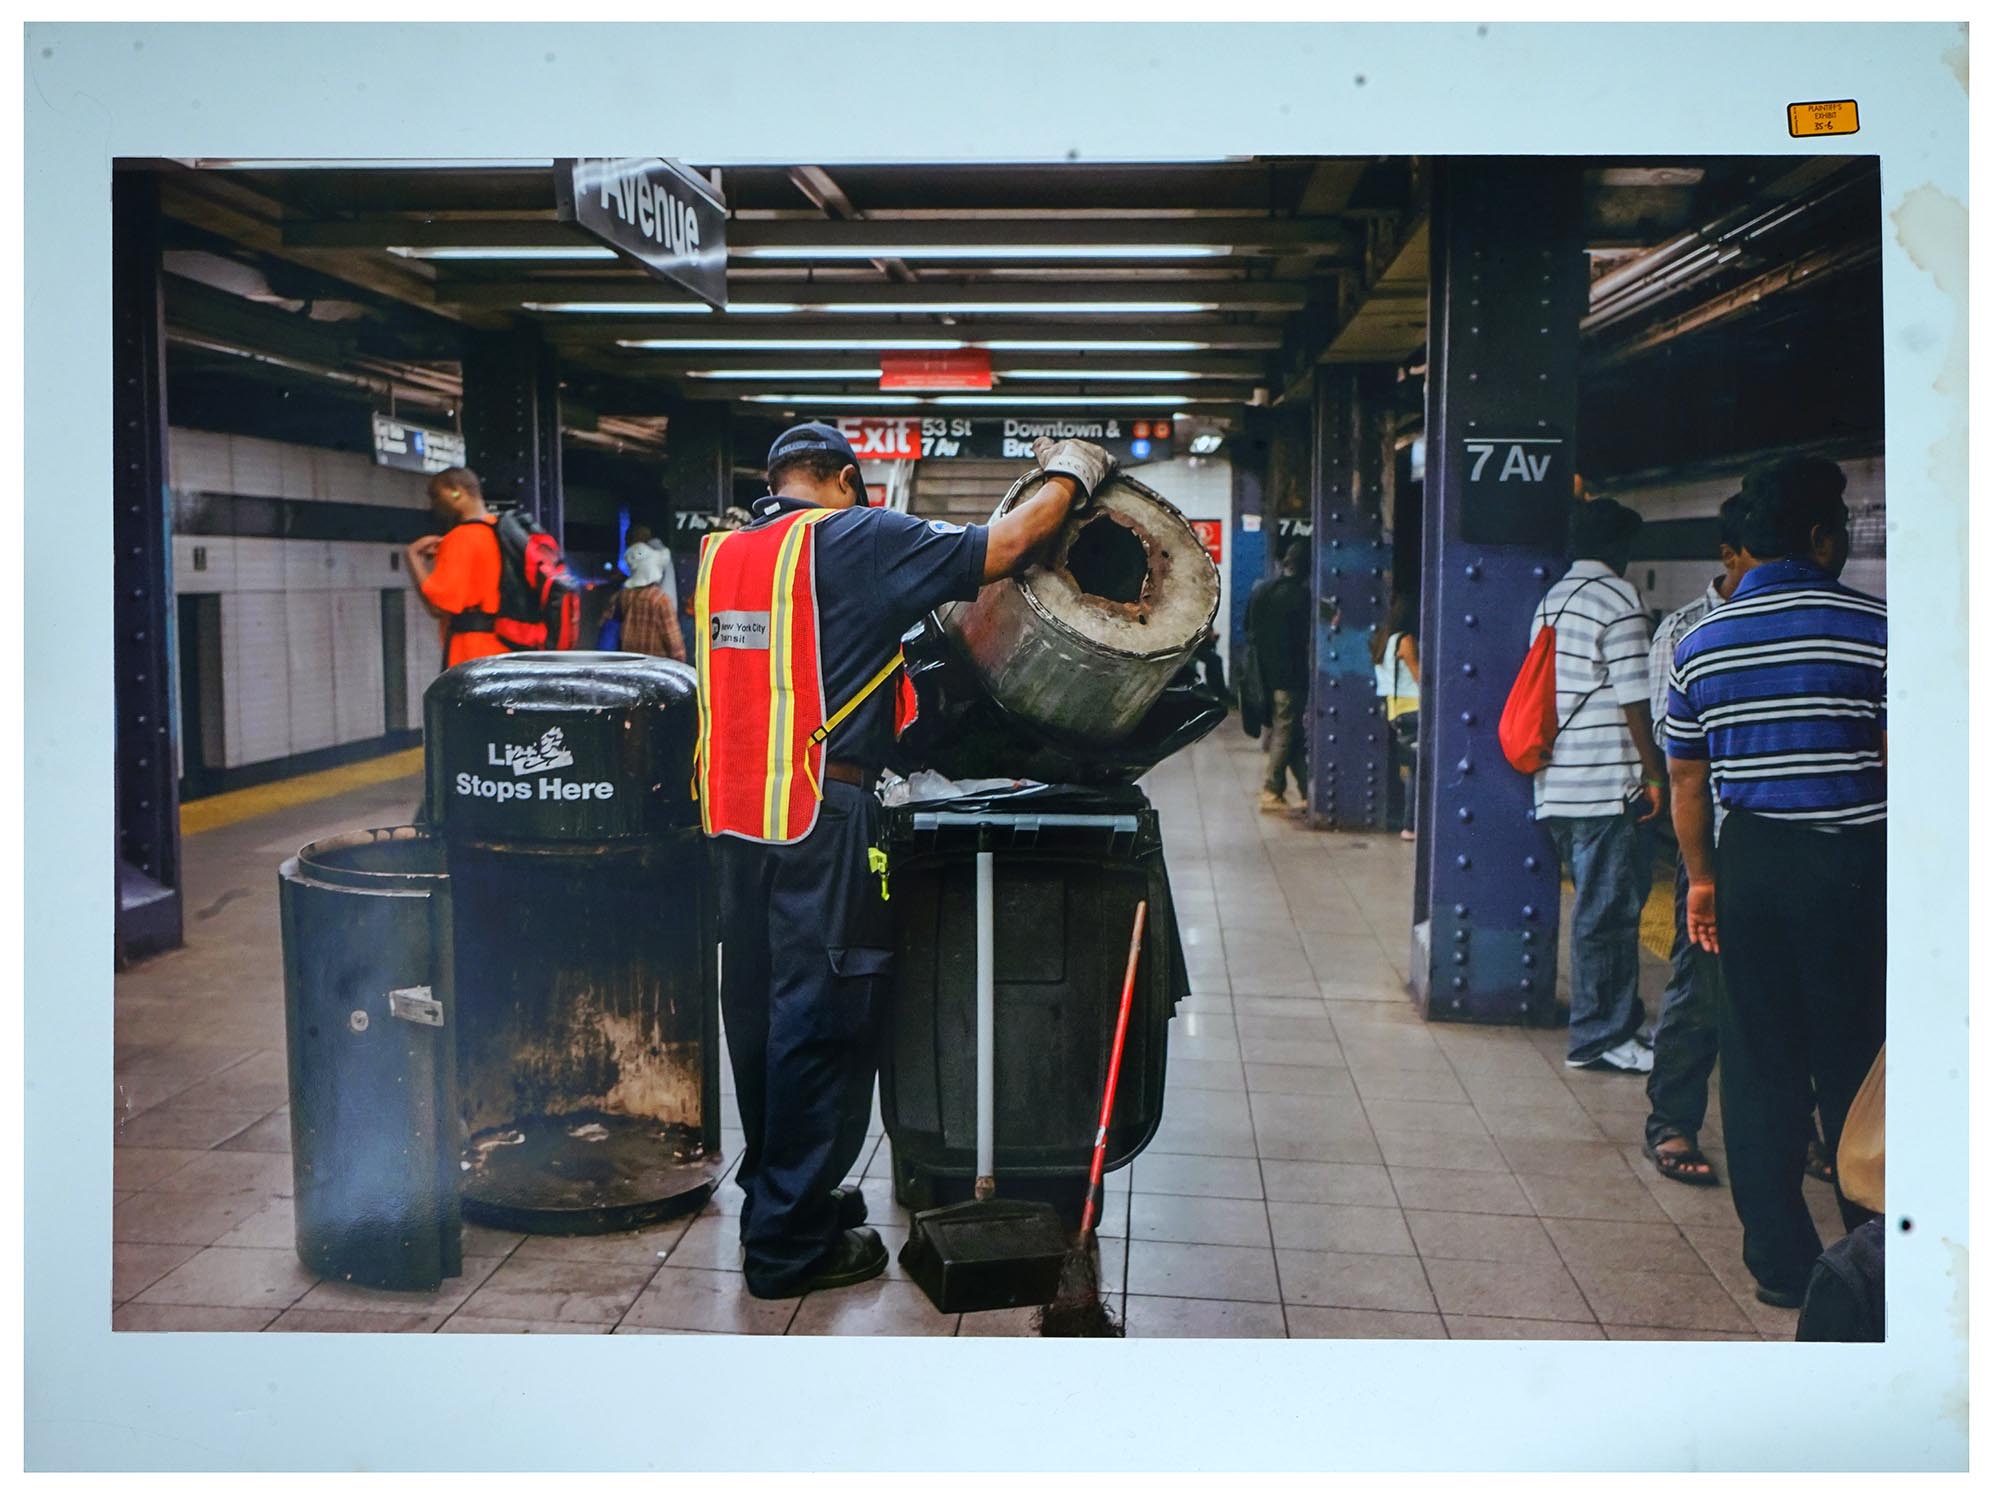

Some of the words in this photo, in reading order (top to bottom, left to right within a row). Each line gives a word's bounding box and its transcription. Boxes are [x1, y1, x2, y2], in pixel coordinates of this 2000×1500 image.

[600, 164, 700, 266] Avenue
[838, 418, 912, 454] Exit
[921, 418, 948, 437] 53
[950, 418, 973, 437] St
[1003, 419, 1103, 438] Downtown
[1105, 418, 1121, 438] &
[921, 438, 935, 456] 7
[934, 438, 960, 456] Av
[1466, 445, 1494, 482] 7
[1498, 445, 1552, 482] Av
[675, 512, 688, 530] 7
[689, 513, 709, 530] Av
[1279, 519, 1291, 536] 7
[1291, 519, 1315, 537] Av
[736, 623, 752, 632] York
[752, 623, 766, 634] City
[456, 772, 533, 802] Stops
[538, 778, 614, 800] Here
